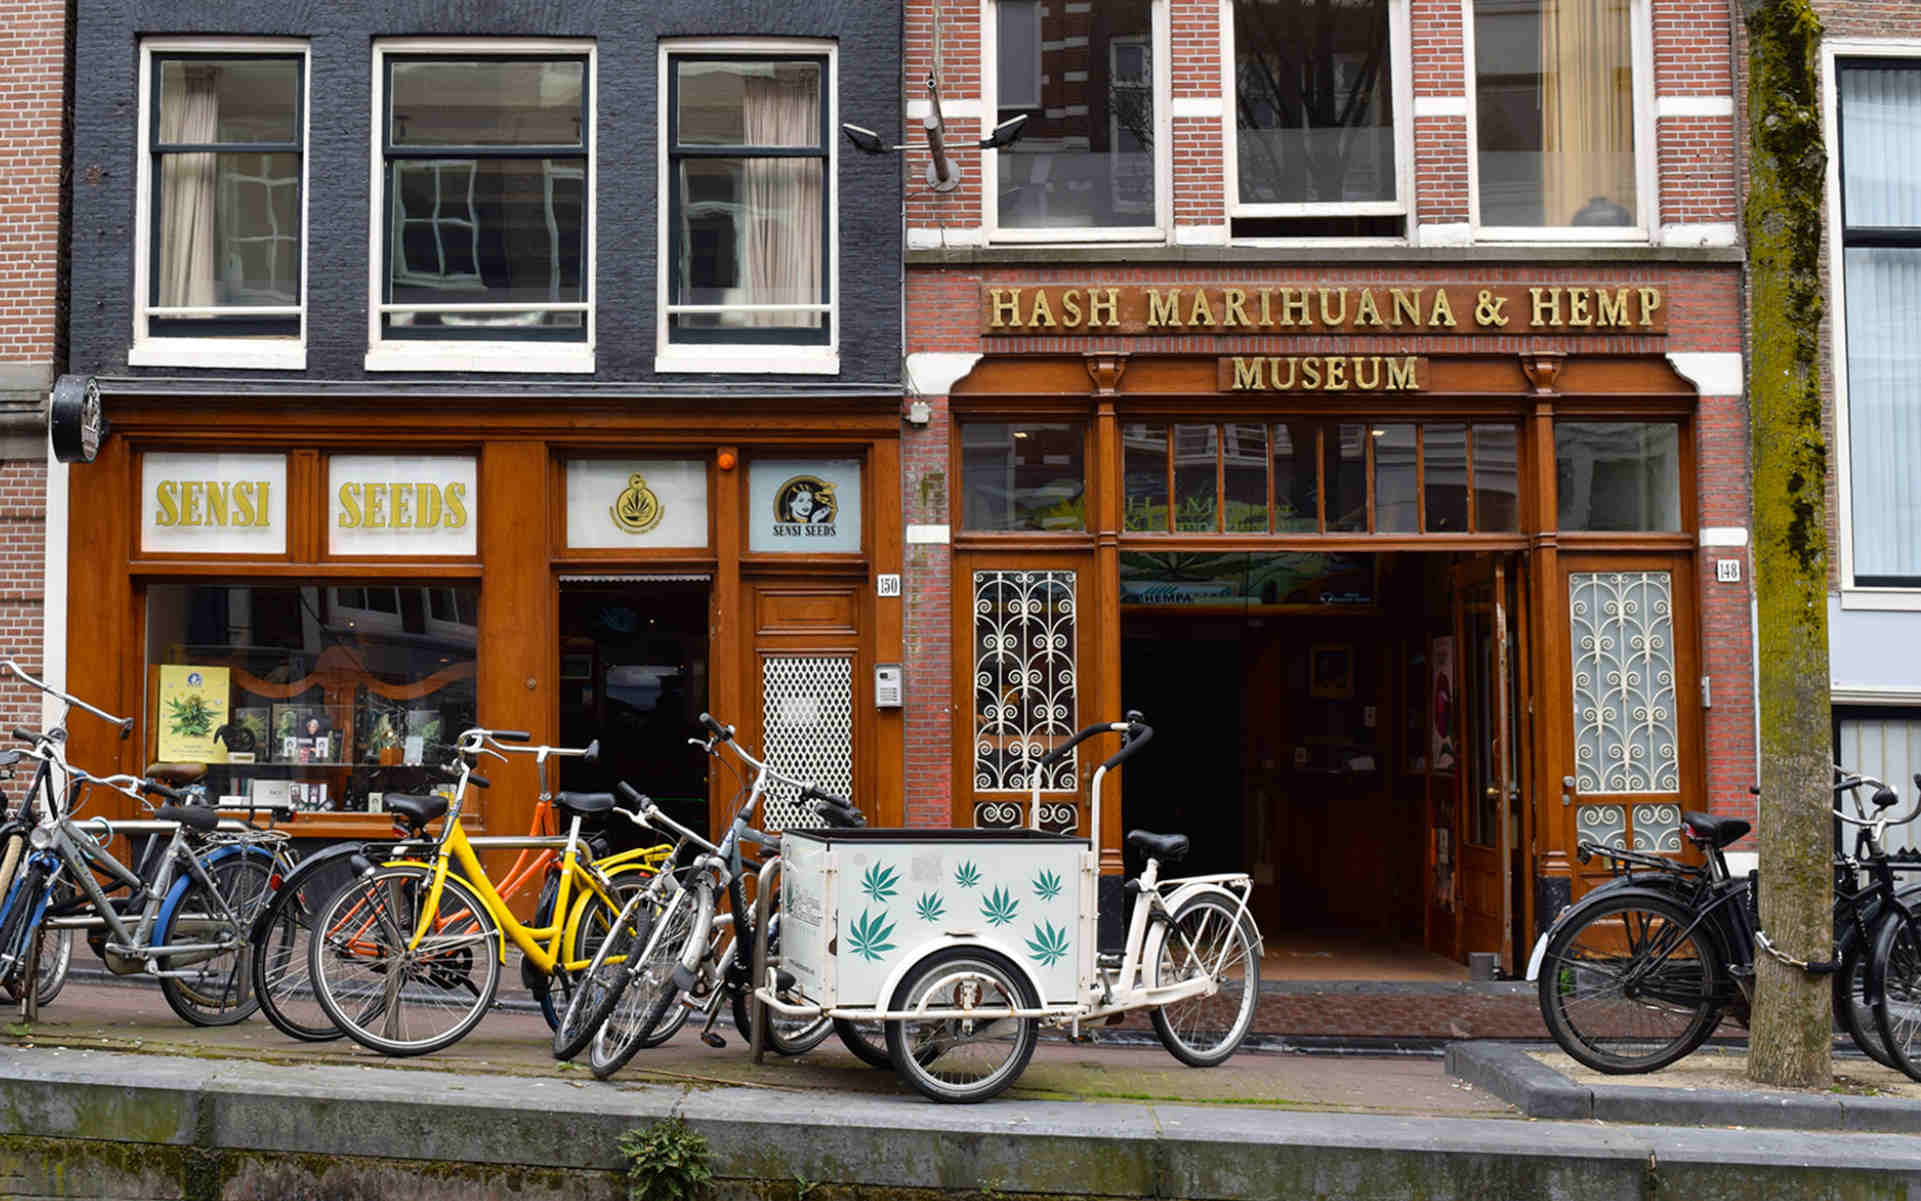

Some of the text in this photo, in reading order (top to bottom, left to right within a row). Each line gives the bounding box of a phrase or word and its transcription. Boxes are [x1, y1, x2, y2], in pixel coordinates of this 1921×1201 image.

[990, 287, 1661, 328] HASH MARIHUANA & HEMP
[1231, 356, 1420, 391] MUSEUM
[155, 480, 468, 529] SENSI SEEDS
[773, 525, 837, 536] SENSI SEEDS
[1719, 562, 1738, 579] 148
[880, 577, 898, 594] 150
